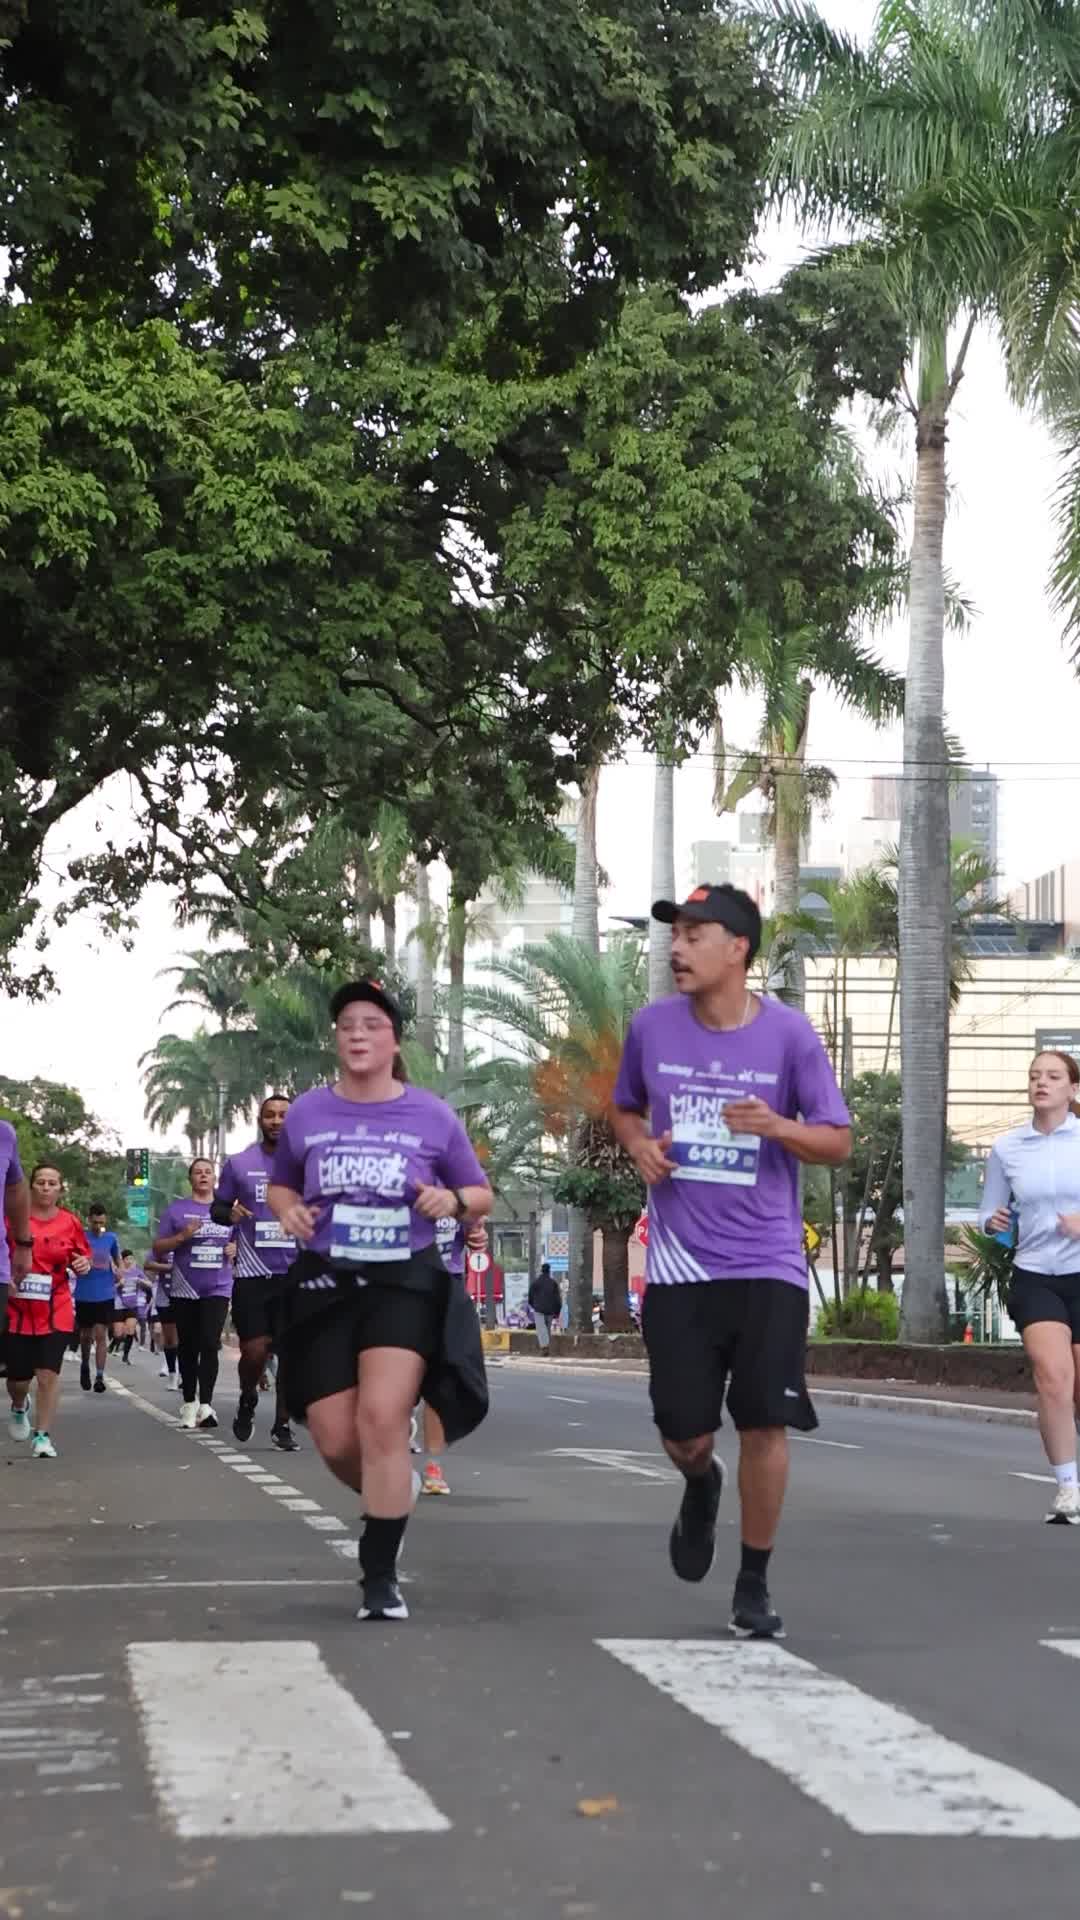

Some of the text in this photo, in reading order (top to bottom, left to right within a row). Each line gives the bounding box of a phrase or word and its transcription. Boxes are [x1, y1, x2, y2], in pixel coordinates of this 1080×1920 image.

[669, 1094, 727, 1113] MUND
[688, 1144, 739, 1165] 6499
[349, 1226, 396, 1243] 5494
